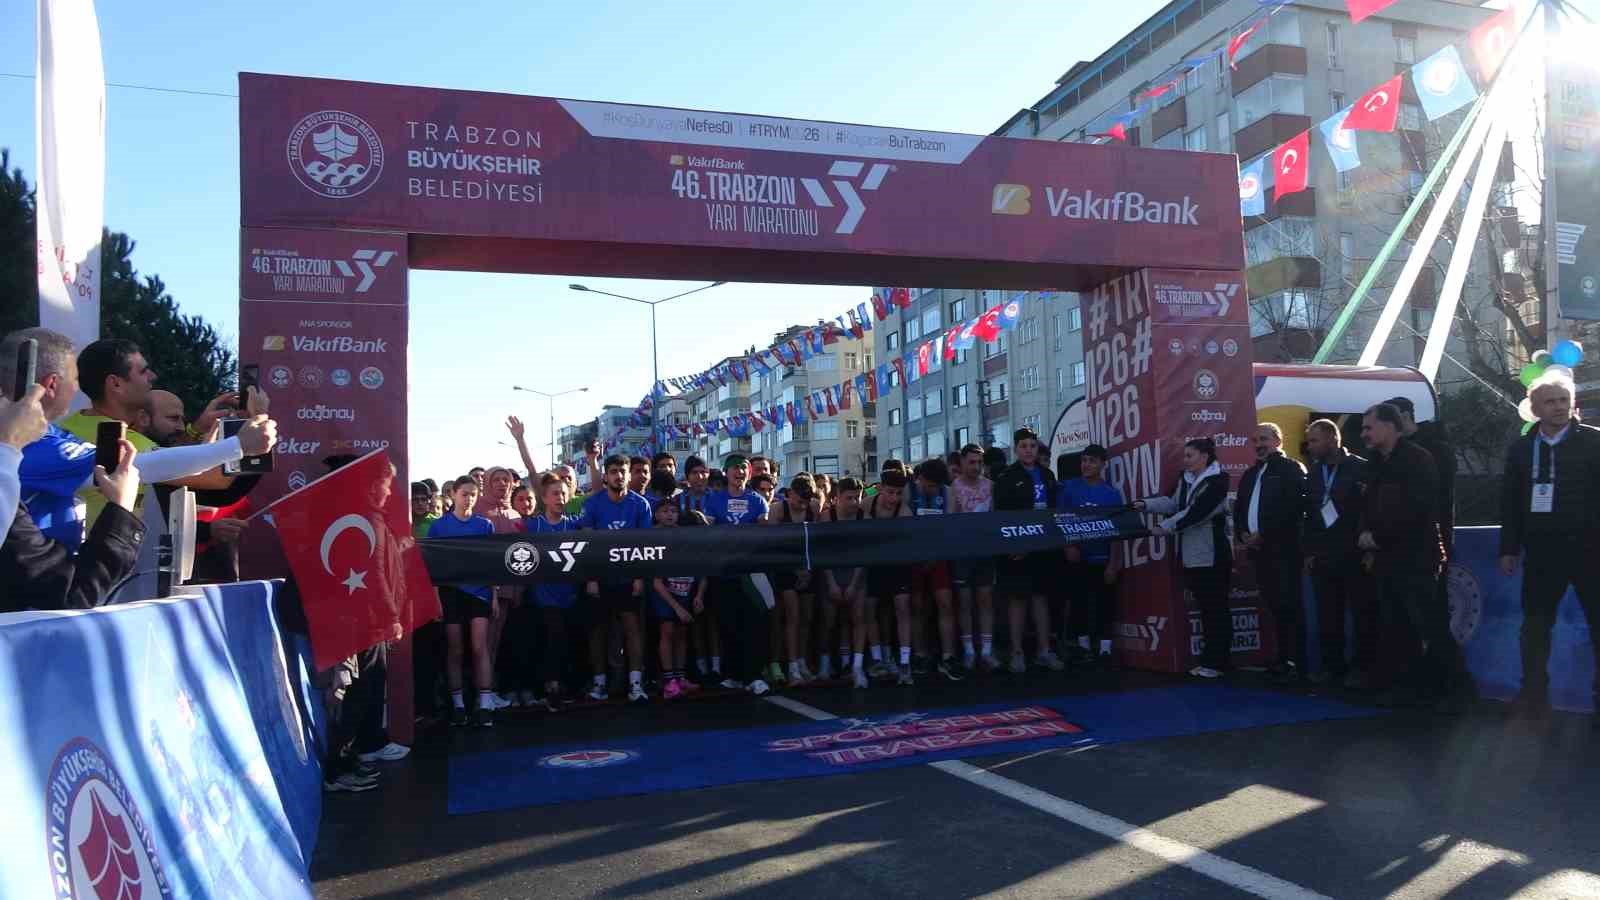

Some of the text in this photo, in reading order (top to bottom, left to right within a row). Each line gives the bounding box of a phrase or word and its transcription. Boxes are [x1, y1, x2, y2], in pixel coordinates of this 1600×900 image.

[407, 121, 542, 148] TRABZON
[407, 150, 541, 176] BÜYÜKŞEHİR
[687, 156, 745, 170] VakıfBank
[407, 178, 544, 204] BELEDİYESİ
[671, 169, 797, 205] 46.TRABZON
[1045, 187, 1199, 225] VakıfBank
[705, 203, 818, 236] YARI MARATONU
[251, 256, 332, 276] 46.TRABZON
[272, 275, 345, 294] YARI MARATONU
[299, 320, 353, 329] ANA SPONSOR
[292, 335, 388, 353] VakıfBank
[278, 437, 320, 454] eker
[1000, 524, 1045, 538] START
[1057, 519, 1115, 534] TRABZON
[608, 546, 666, 563] START
[770, 724, 909, 752] SPOR
[808, 718, 1068, 765] TRABZON
